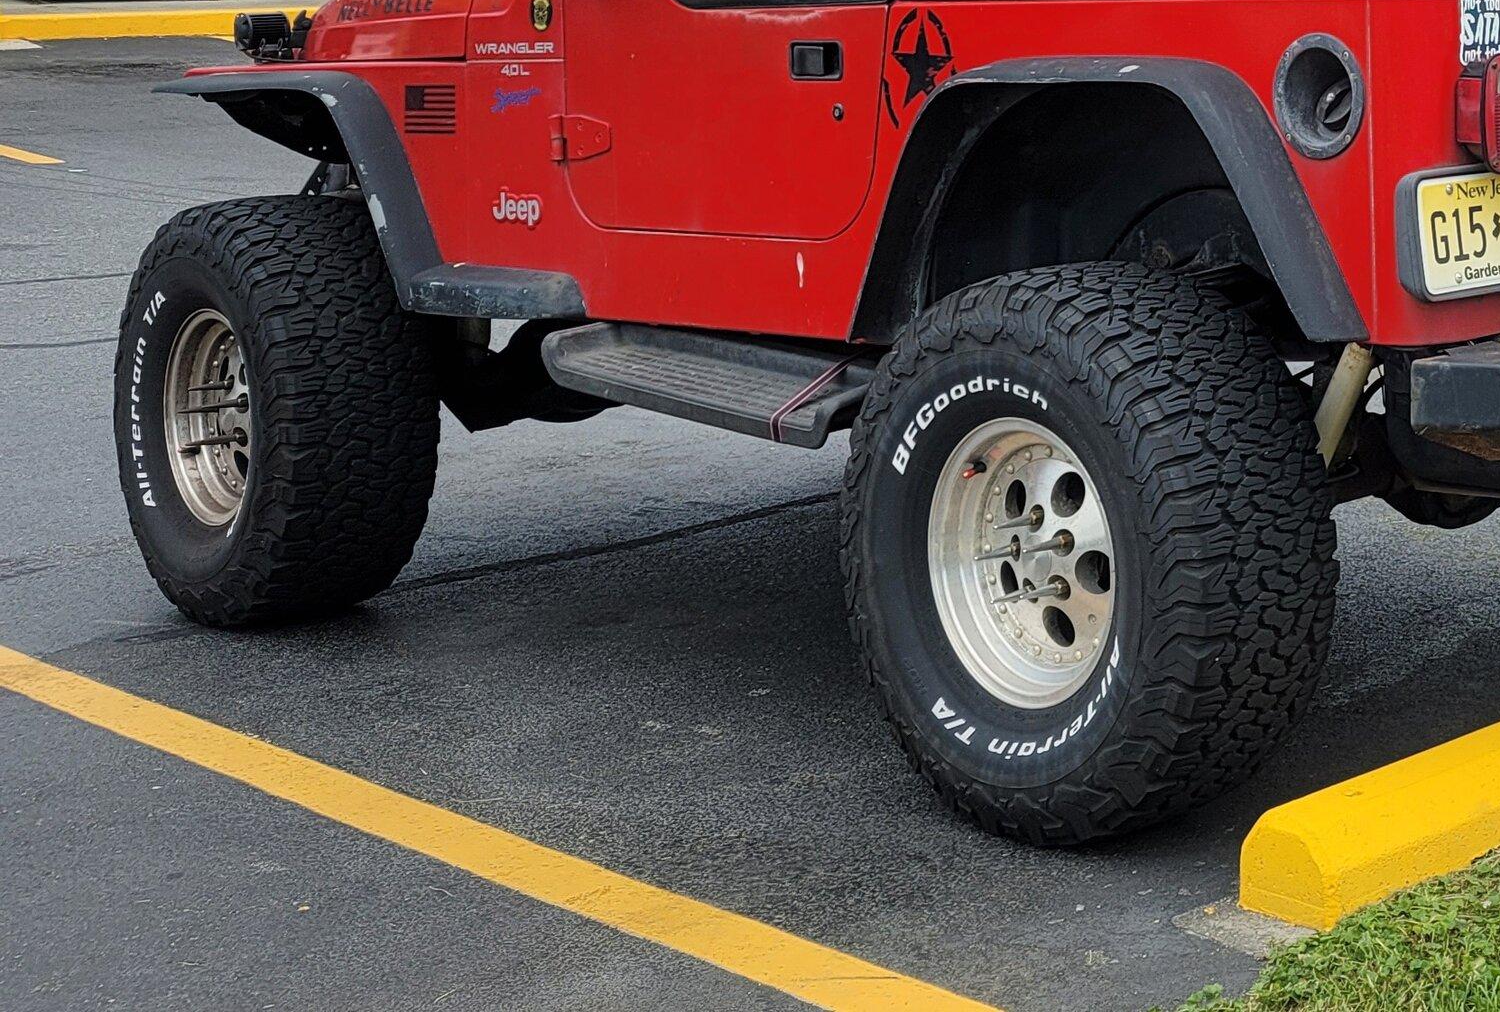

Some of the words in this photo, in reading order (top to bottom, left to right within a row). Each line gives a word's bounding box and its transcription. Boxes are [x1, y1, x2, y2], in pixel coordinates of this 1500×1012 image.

[475, 42, 554, 54] WRANGLER
[1464, 46, 1482, 62] not
[492, 191, 540, 226] Jeep
[1456, 181, 1488, 199] New
[1430, 205, 1487, 264] G15
[142, 290, 166, 326] T/A
[130, 337, 157, 508] All-Terrain
[891, 375, 1049, 476] BFGoodrich
[987, 634, 1120, 761] All-Terrain
[931, 696, 980, 746] T/A
